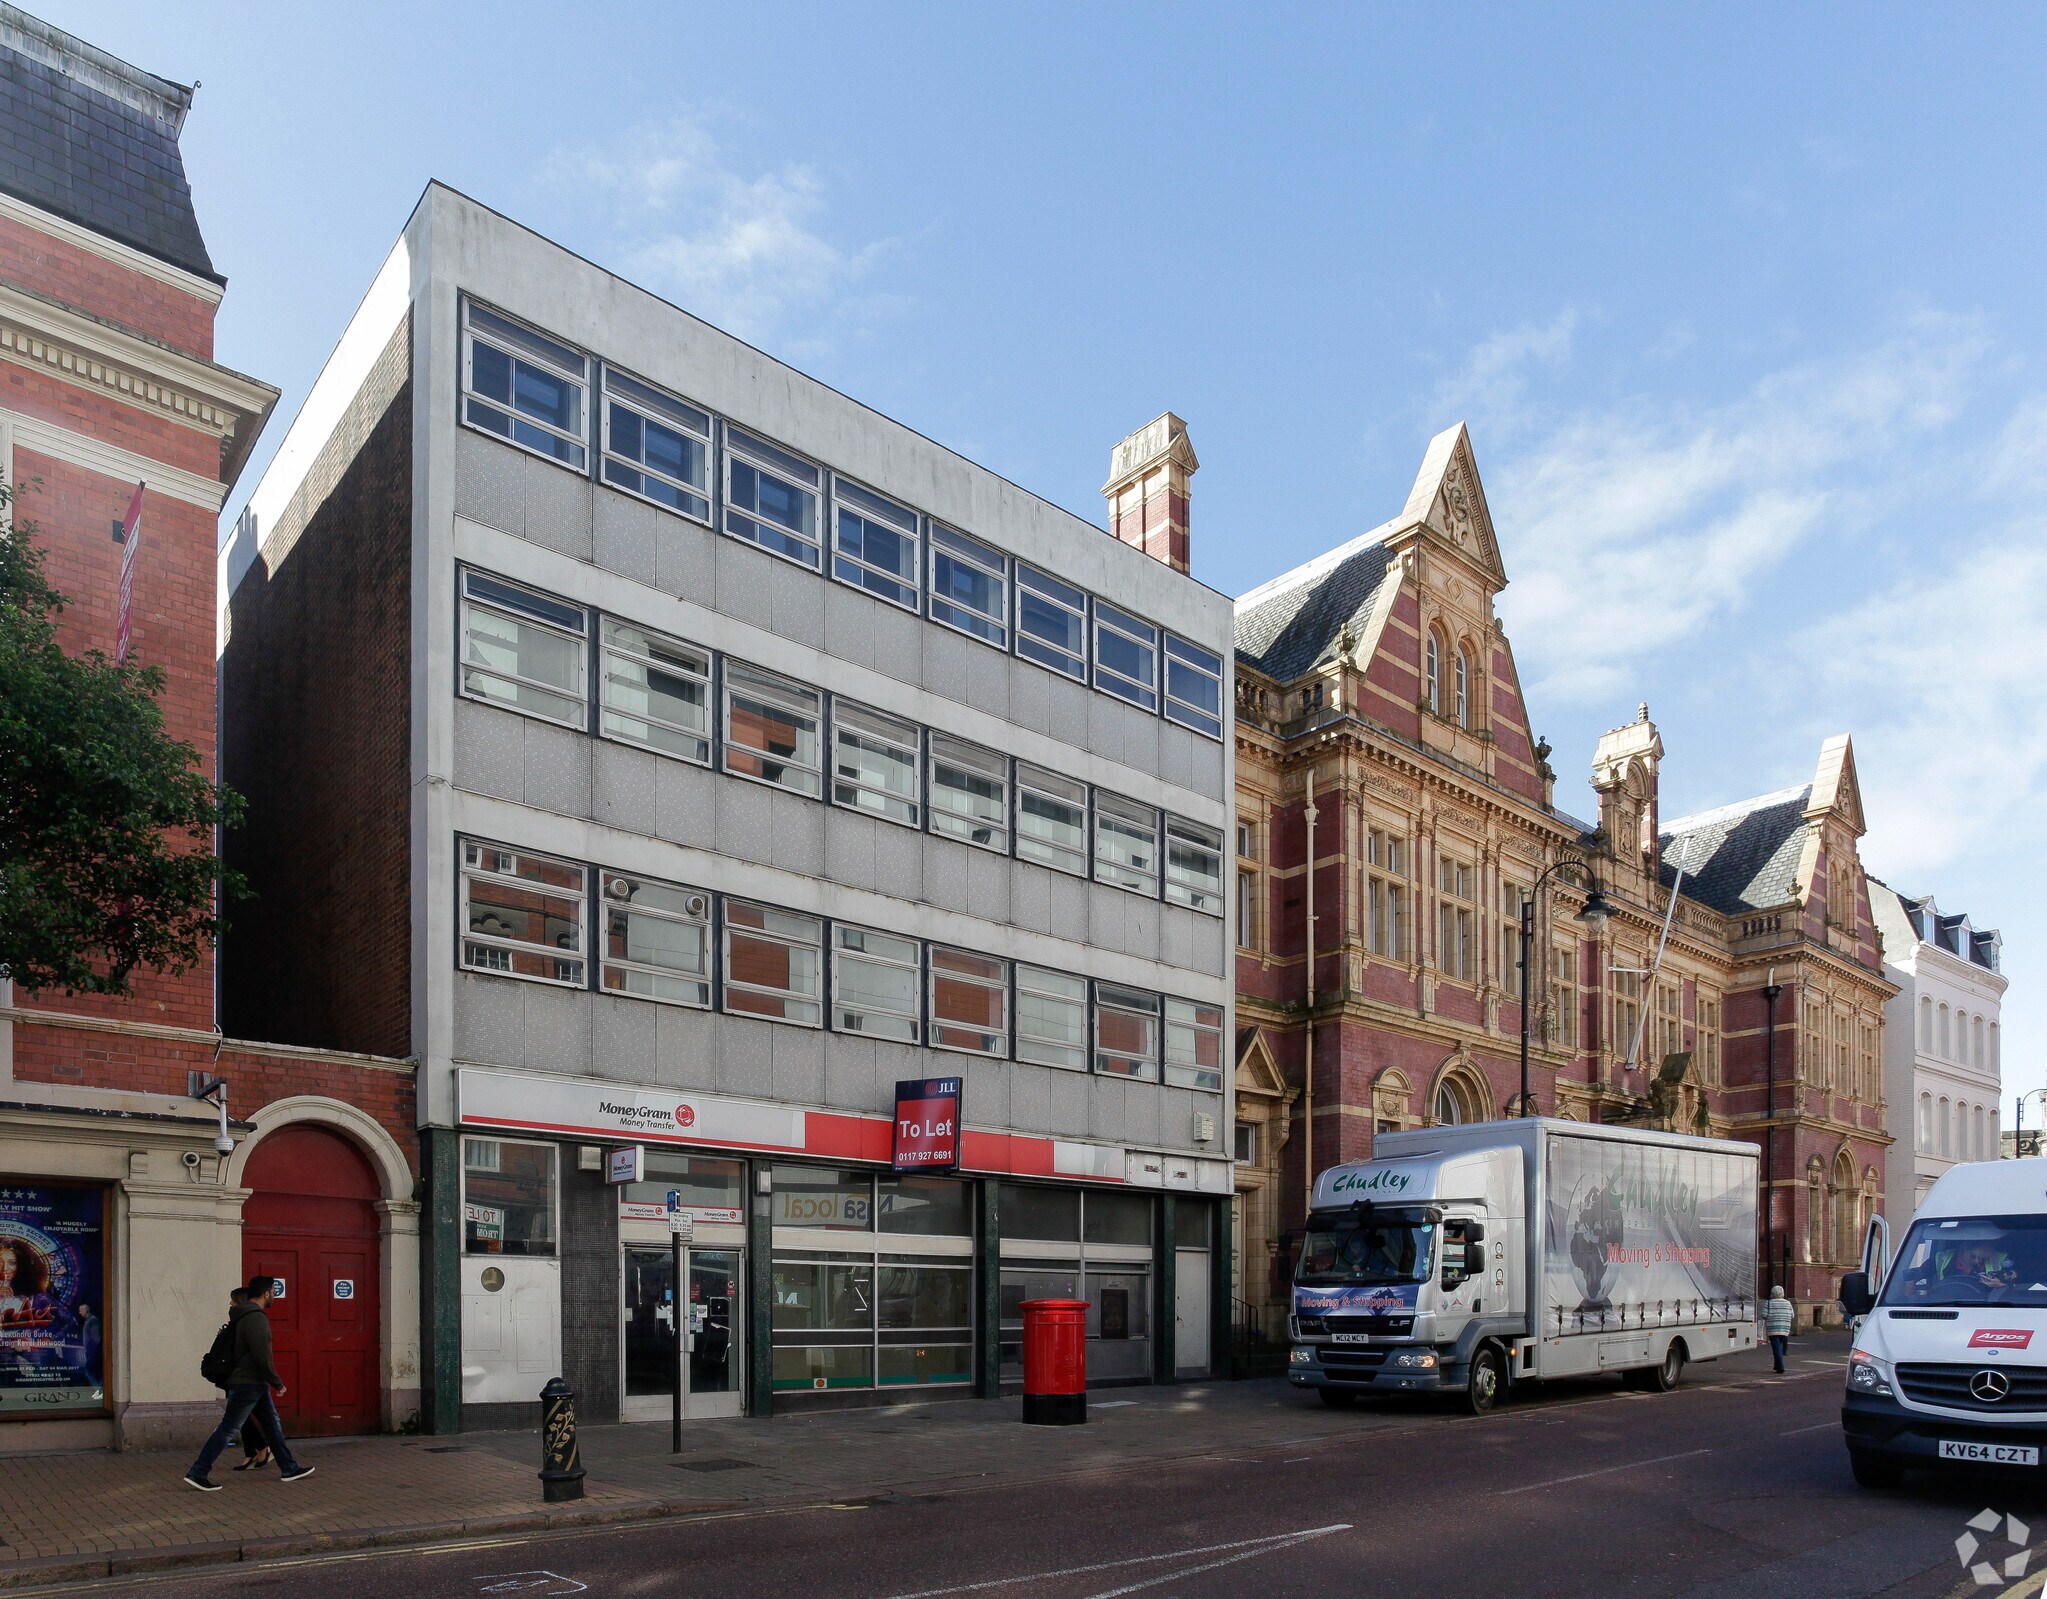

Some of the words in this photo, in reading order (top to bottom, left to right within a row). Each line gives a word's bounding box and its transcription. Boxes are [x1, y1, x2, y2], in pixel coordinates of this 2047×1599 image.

[938, 1082, 956, 1093] JLL
[599, 1101, 671, 1119] MoneyGram
[619, 1117, 645, 1129] Money
[646, 1119, 675, 1130] Transfer
[900, 1120, 921, 1138] To
[925, 1119, 952, 1137] Let
[898, 1152, 916, 1161] 0117
[918, 1151, 932, 1160] 927
[933, 1150, 952, 1160] 6691
[1332, 1169, 1411, 1193] Chudley
[1607, 1163, 1700, 1232] Chudley
[1606, 1242, 1650, 1269] Moving
[1654, 1243, 1662, 1263] &
[1665, 1241, 1710, 1269] Shipping
[1301, 1297, 1340, 1310] Moving
[1341, 1296, 1351, 1307] &
[1352, 1295, 1405, 1310] Shipping
[1388, 1319, 1411, 1327] LF
[33, 1329, 53, 1338] Burke
[1977, 1332, 2027, 1342] Argos
[17, 1338, 36, 1347] Revel
[37, 1337, 66, 1347] Horwood
[24, 1391, 80, 1403] GRAND
[1945, 1443, 1990, 1459] KV64
[1995, 1447, 2031, 1462] CZT
